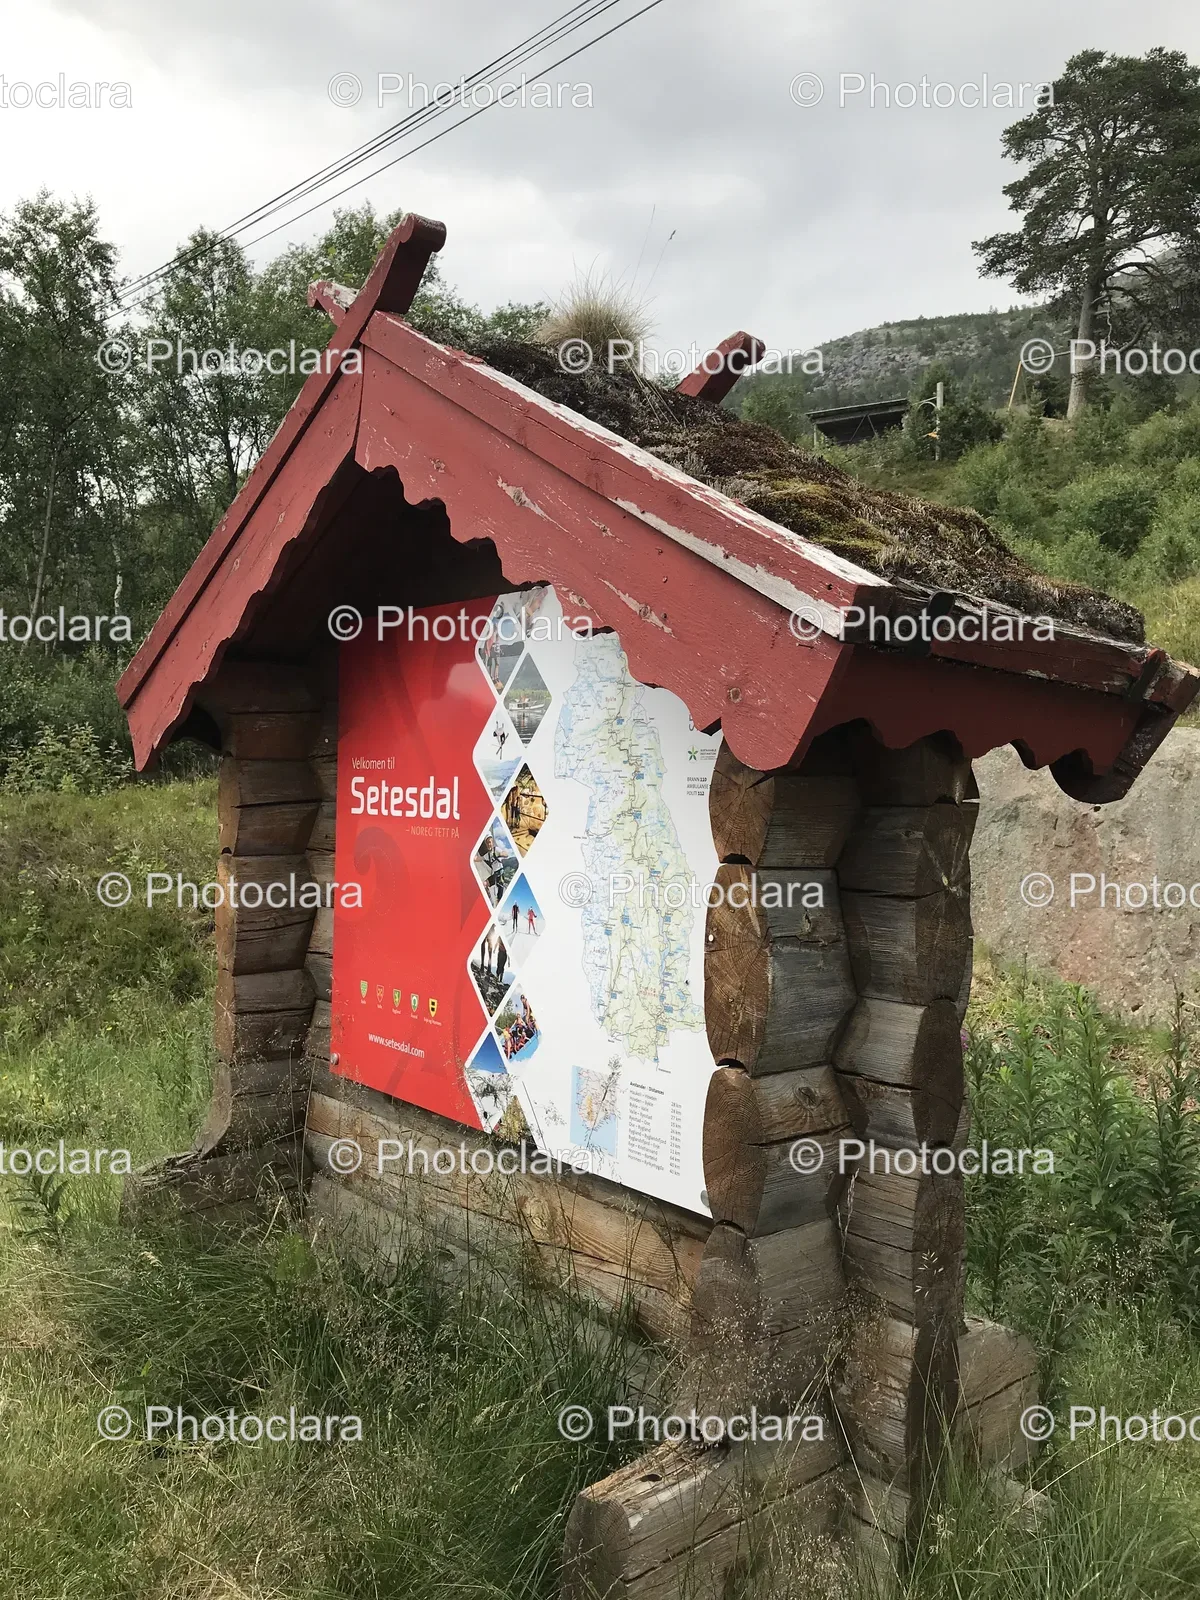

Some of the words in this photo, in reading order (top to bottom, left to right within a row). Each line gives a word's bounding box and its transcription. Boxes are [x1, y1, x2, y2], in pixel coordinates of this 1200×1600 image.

[352, 757, 385, 769] Velkomen
[351, 776, 460, 820] Setesdal
[411, 826, 432, 836] NOREG
[435, 827, 449, 837] TETT
[451, 827, 459, 838] PÅ
[368, 1033, 424, 1058] www.setesdal.com
